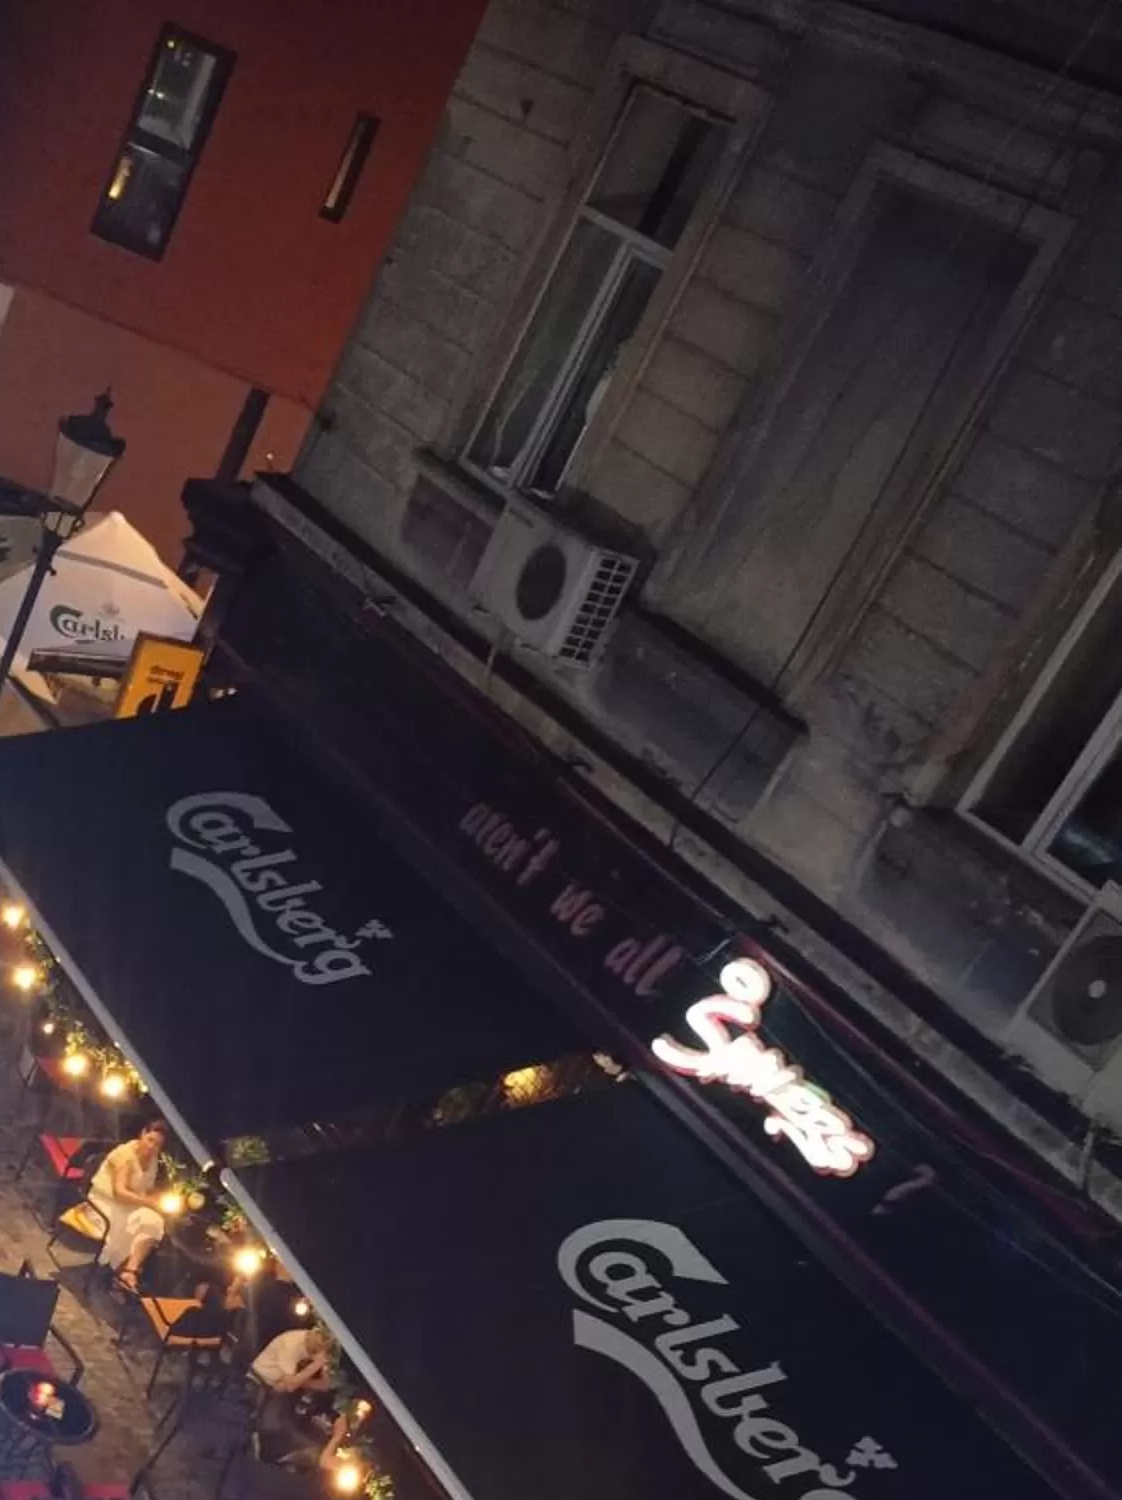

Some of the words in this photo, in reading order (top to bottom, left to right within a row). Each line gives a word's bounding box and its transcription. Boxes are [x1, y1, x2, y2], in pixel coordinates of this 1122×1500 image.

[166, 791, 374, 985] Carlsberg
[459, 803, 559, 886] aren't
[549, 884, 605, 936] we
[604, 934, 685, 997] all
